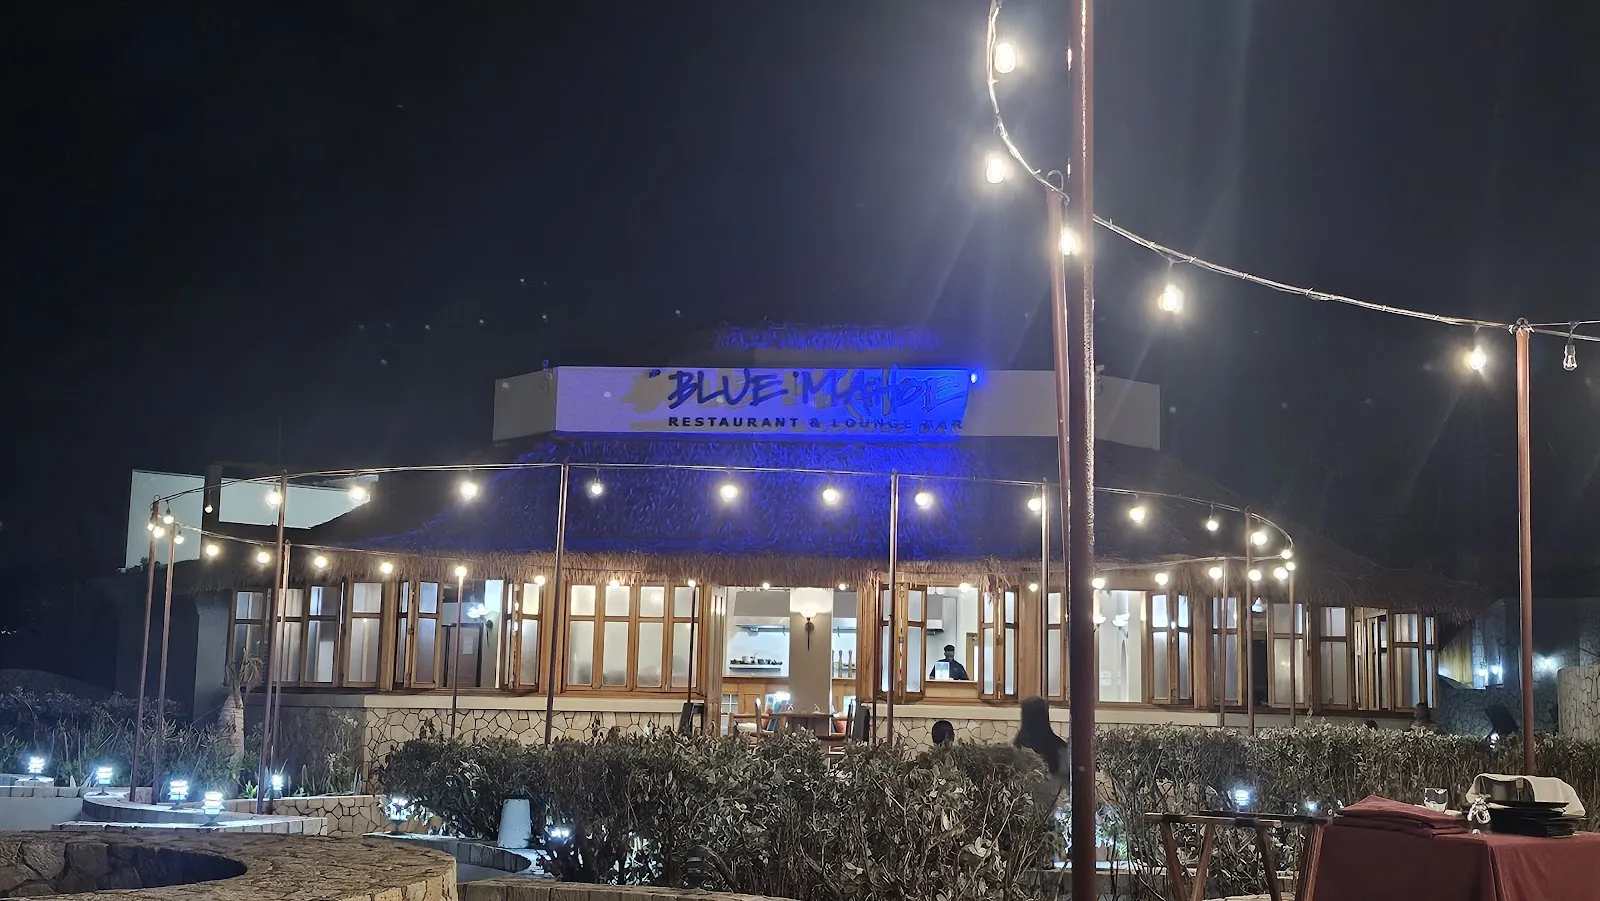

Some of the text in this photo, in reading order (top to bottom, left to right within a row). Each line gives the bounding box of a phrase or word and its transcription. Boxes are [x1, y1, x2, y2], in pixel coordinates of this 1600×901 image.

[667, 368, 788, 410] BLUE
[668, 416, 963, 431] RESTAURANT & LOUNGE BAR
